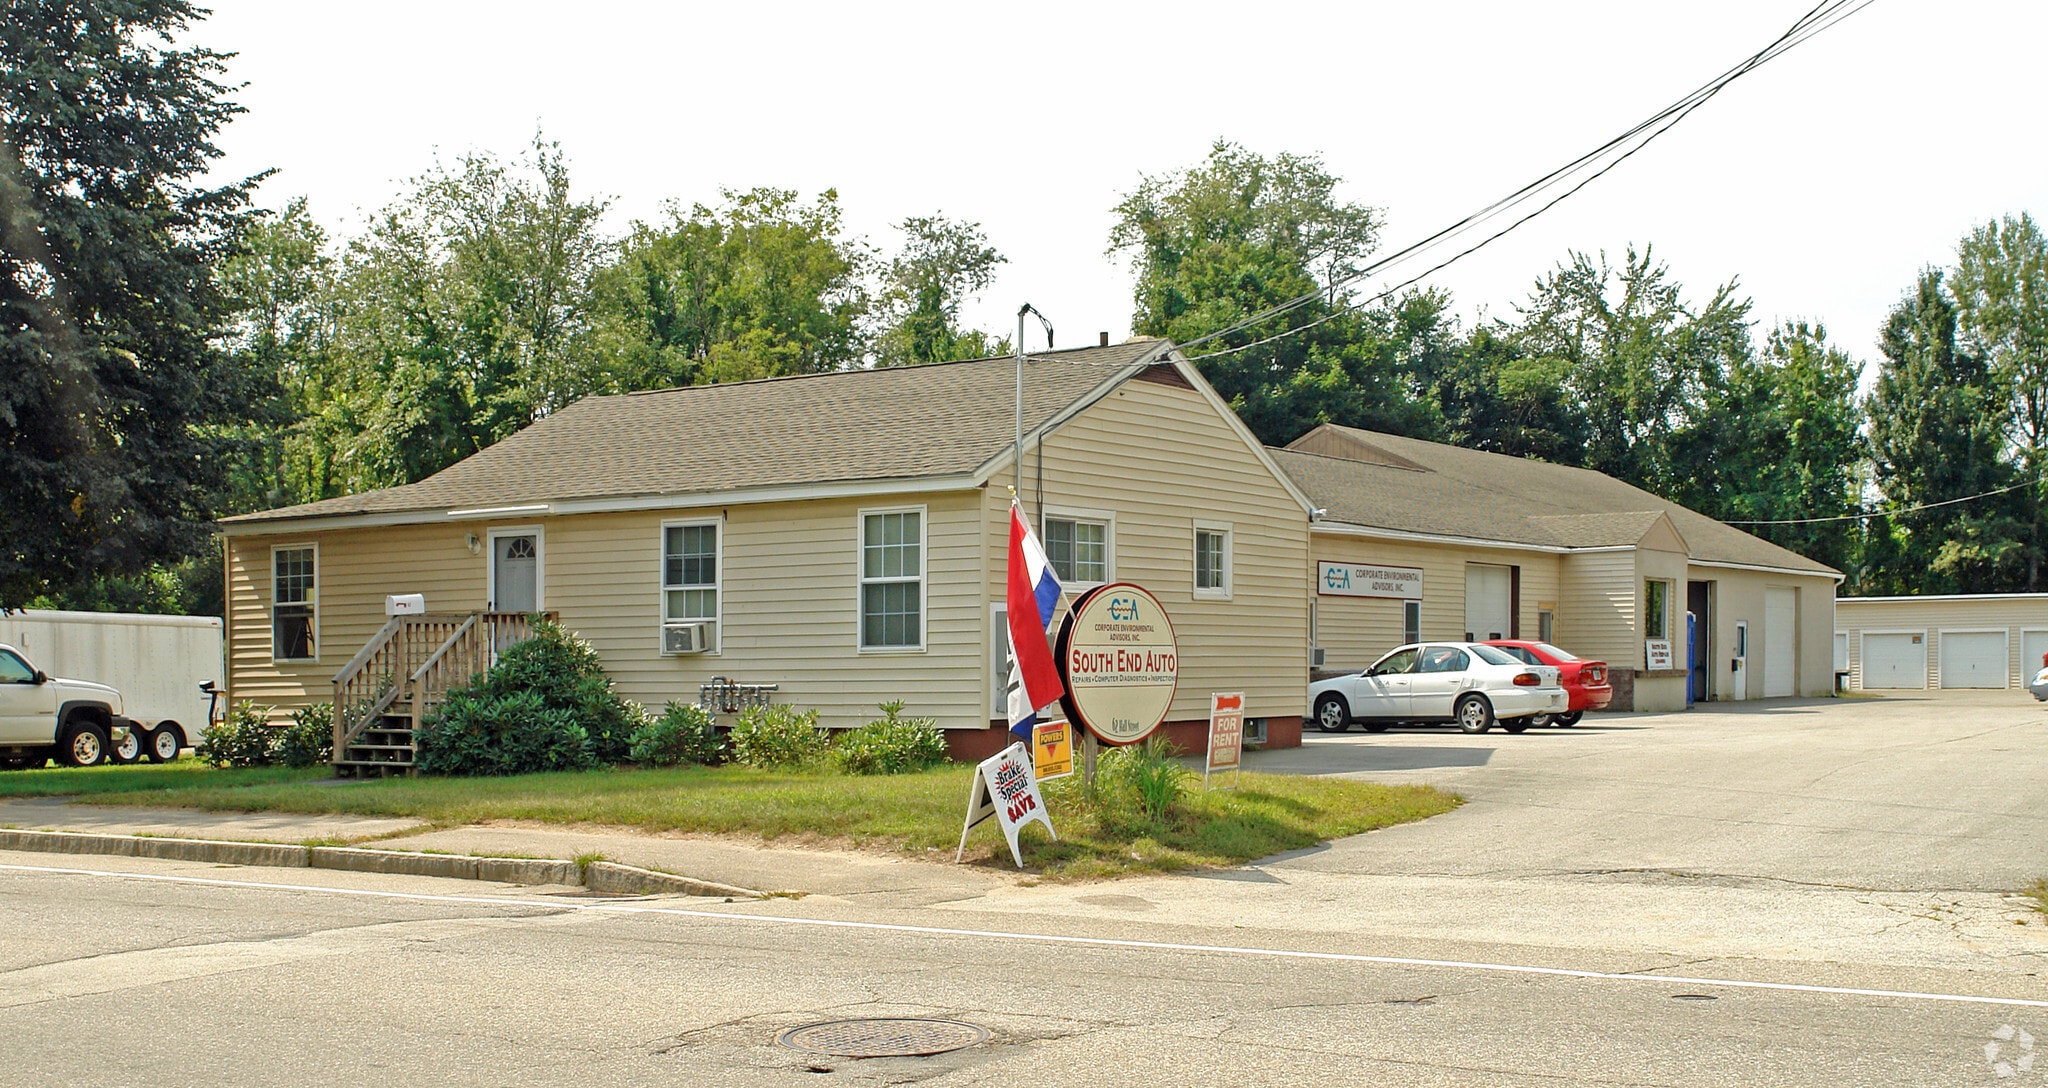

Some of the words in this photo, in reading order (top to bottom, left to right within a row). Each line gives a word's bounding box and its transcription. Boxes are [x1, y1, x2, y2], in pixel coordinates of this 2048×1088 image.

[1327, 567, 1350, 589] CEA
[1355, 569, 1383, 579] CORPORATE
[1384, 571, 1419, 582] ENVIRONMENTAL
[1111, 598, 1139, 620] CEA
[1095, 623, 1120, 632] CORPORATE
[1120, 624, 1154, 632] ENVIRONMENTAL
[1072, 649, 1113, 673] SOUTH
[1117, 649, 1142, 672] END
[1145, 649, 1175, 672] AUTO
[1072, 675, 1091, 683] REPAIRS
[1094, 675, 1118, 683] COMPUTER
[1120, 674, 1148, 682] DIAGNOSTICS
[1111, 717, 1119, 734] 62
[1217, 717, 1237, 732] FOR
[1041, 731, 1063, 744] POWERS
[1213, 732, 1239, 748] RENT
[997, 763, 1022, 785] Brake
[1000, 773, 1028, 801] Special
